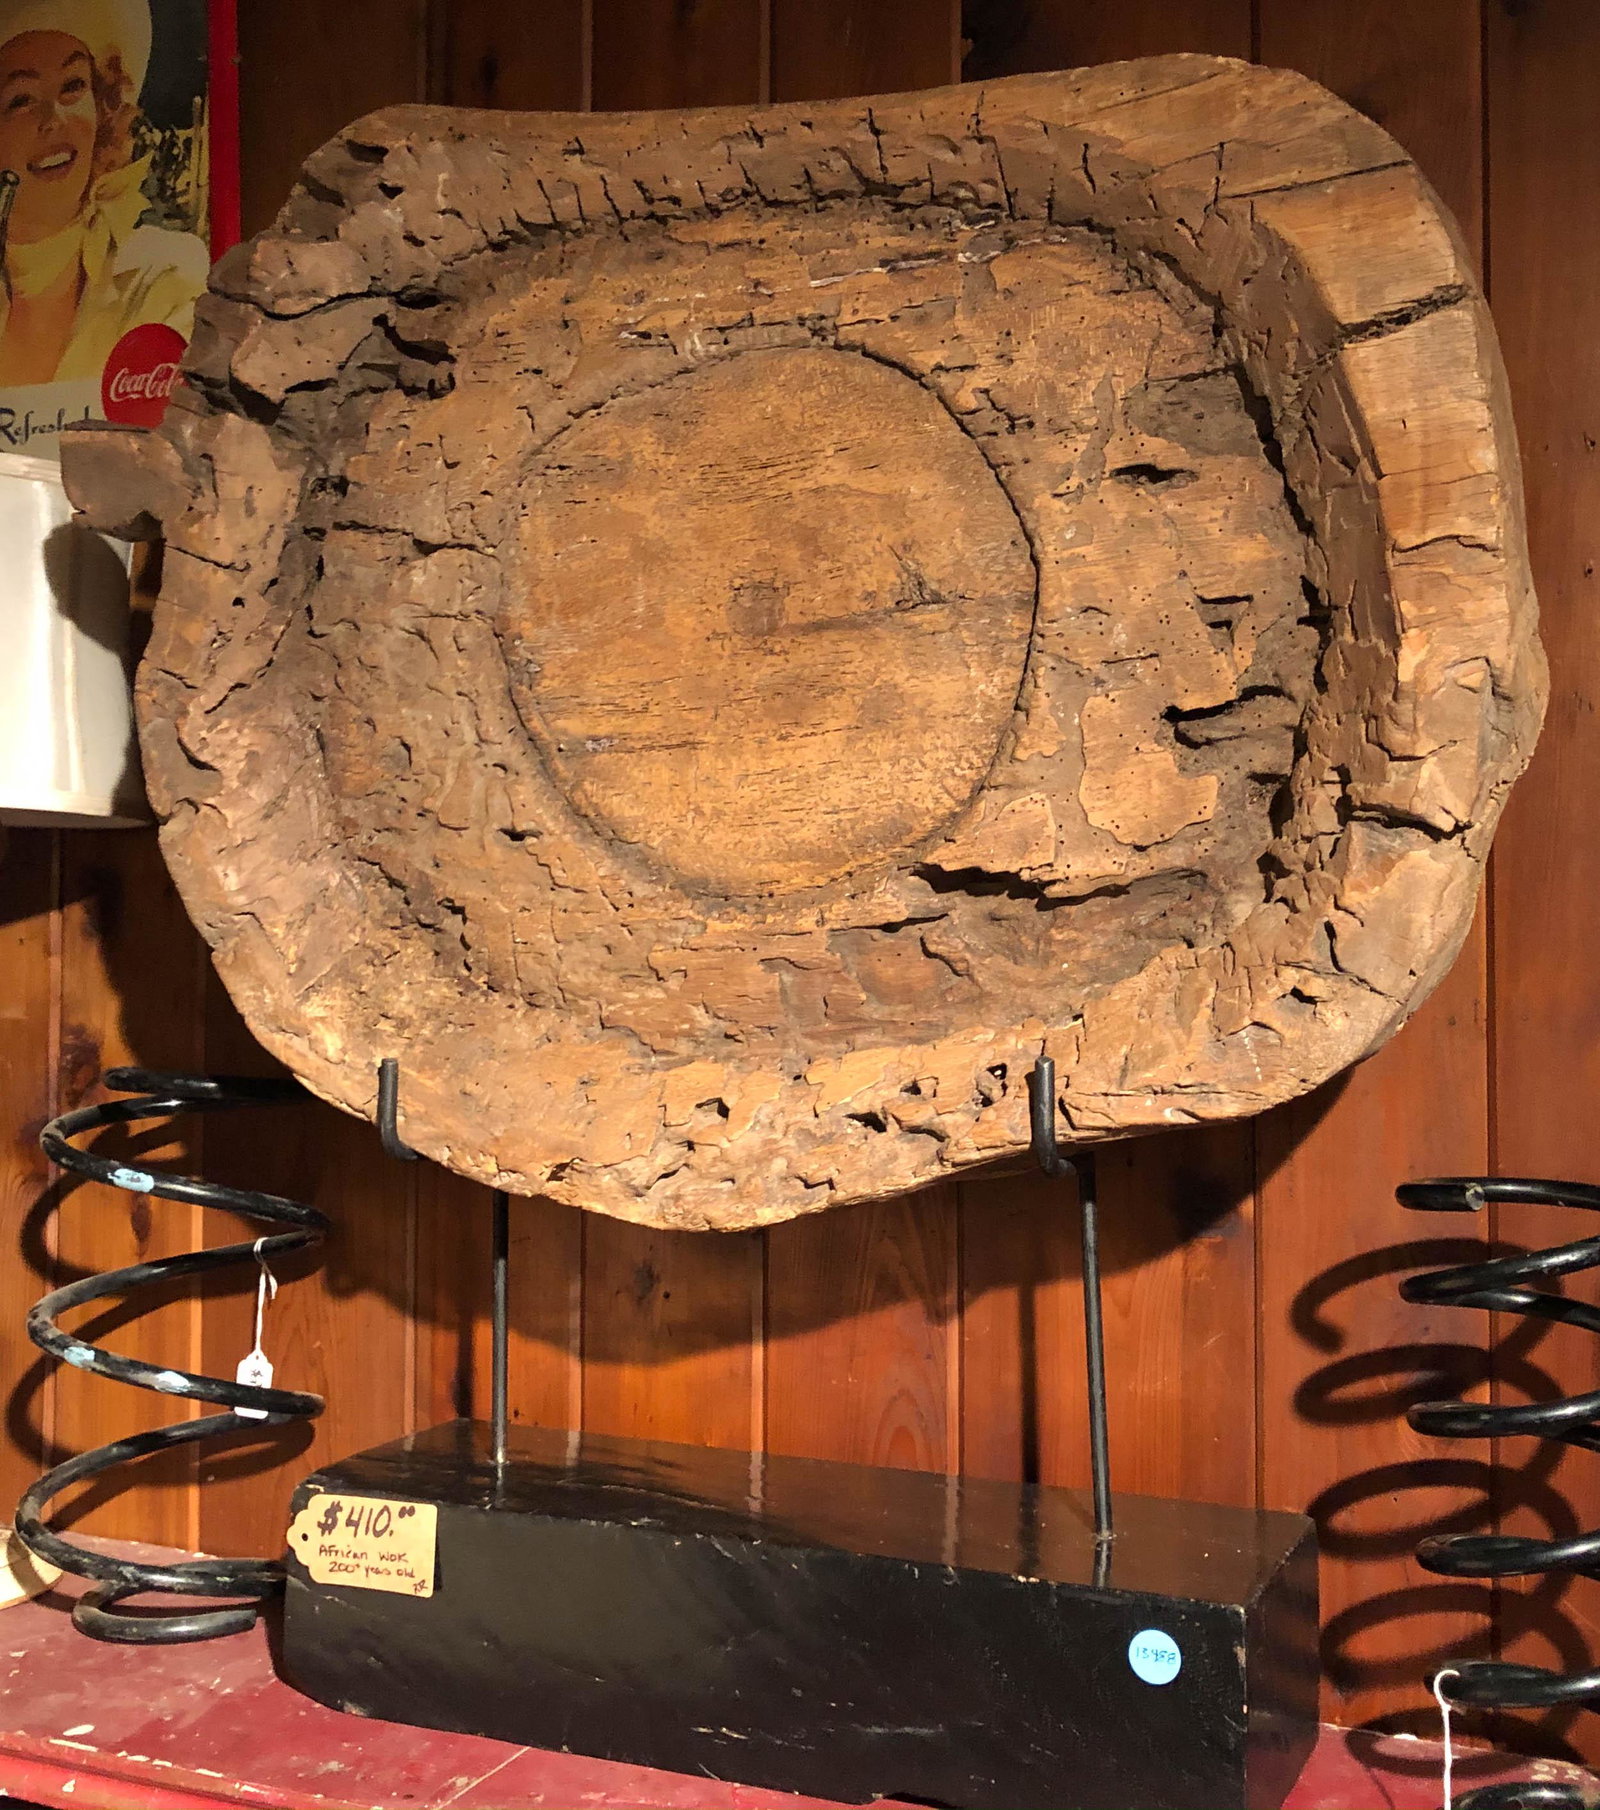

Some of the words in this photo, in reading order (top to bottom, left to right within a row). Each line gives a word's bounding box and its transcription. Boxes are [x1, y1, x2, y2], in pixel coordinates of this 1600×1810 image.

[110, 362, 181, 402] Coca-Col
[364, 1565, 391, 1578] years
[396, 1567, 416, 1579] old
